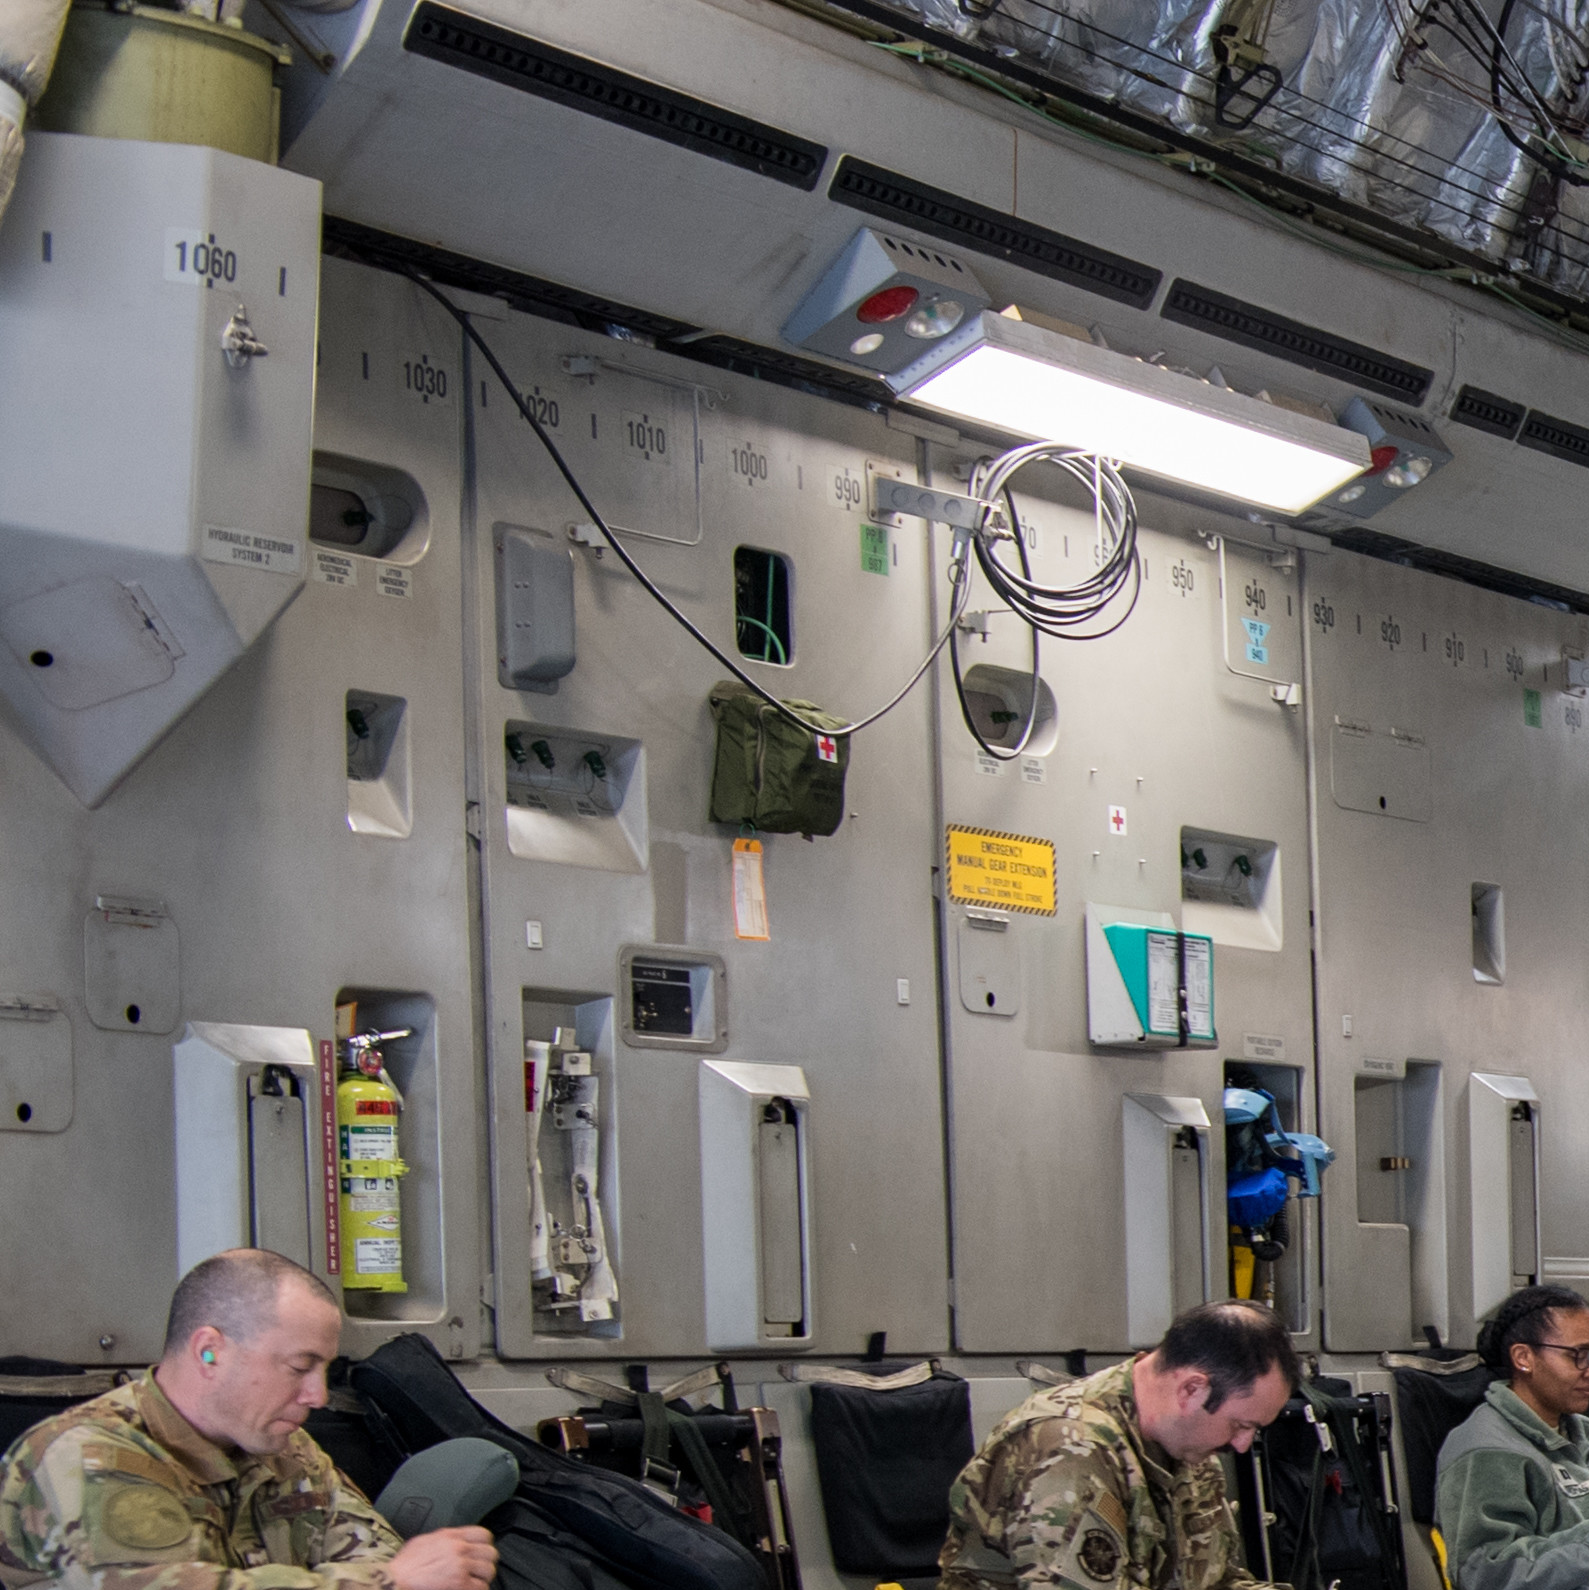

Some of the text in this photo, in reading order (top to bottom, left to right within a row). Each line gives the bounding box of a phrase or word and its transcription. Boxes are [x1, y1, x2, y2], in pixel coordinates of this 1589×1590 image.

[176, 241, 236, 282] 1060
[404, 361, 447, 397] 1030
[628, 421, 665, 454] 1010
[731, 448, 767, 480] 1000
[835, 476, 861, 504] 990
[208, 528, 294, 554] HYDRAULIC RESERVOIR
[232, 547, 262, 563] SYSTEM
[379, 576, 408, 588] EMERGENCY
[1172, 566, 1193, 590] 950
[1245, 585, 1266, 609] 940
[1314, 603, 1334, 627] 930
[1381, 620, 1400, 645] 920
[1446, 637, 1464, 661] 910
[1506, 653, 1523, 676] 900
[1565, 706, 1581, 728] 890
[981, 841, 1022, 858] EMERGENCY
[957, 854, 1047, 878] MANUAL GEAR EXTENSION
[323, 1043, 337, 1270] FIRE EXTINGUISHER
